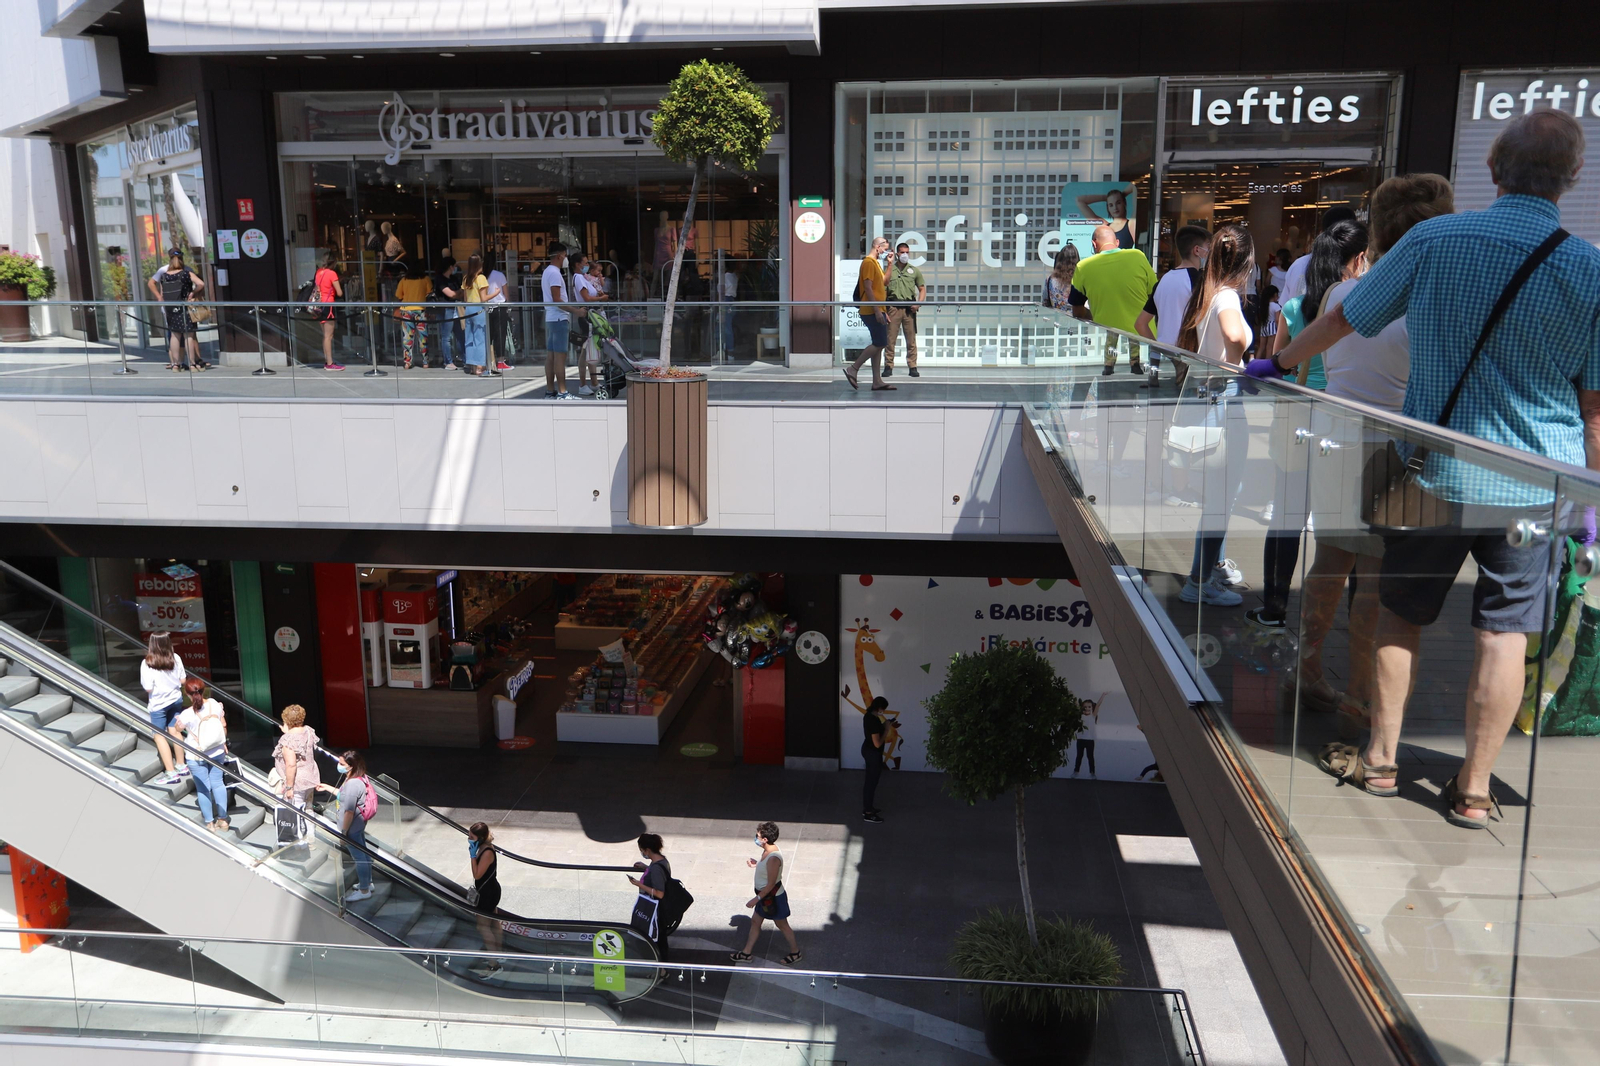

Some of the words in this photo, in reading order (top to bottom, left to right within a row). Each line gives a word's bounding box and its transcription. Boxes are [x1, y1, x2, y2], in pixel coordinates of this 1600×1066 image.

[1191, 85, 1360, 126] lefties
[409, 97, 657, 142] stradivarius
[131, 116, 191, 163] stradivarius
[1247, 182, 1303, 194] Esenciales
[439, 570, 455, 584] DRINKS
[138, 577, 197, 594] rebajas
[152, 606, 189, 620] -50%
[975, 609, 984, 619] &
